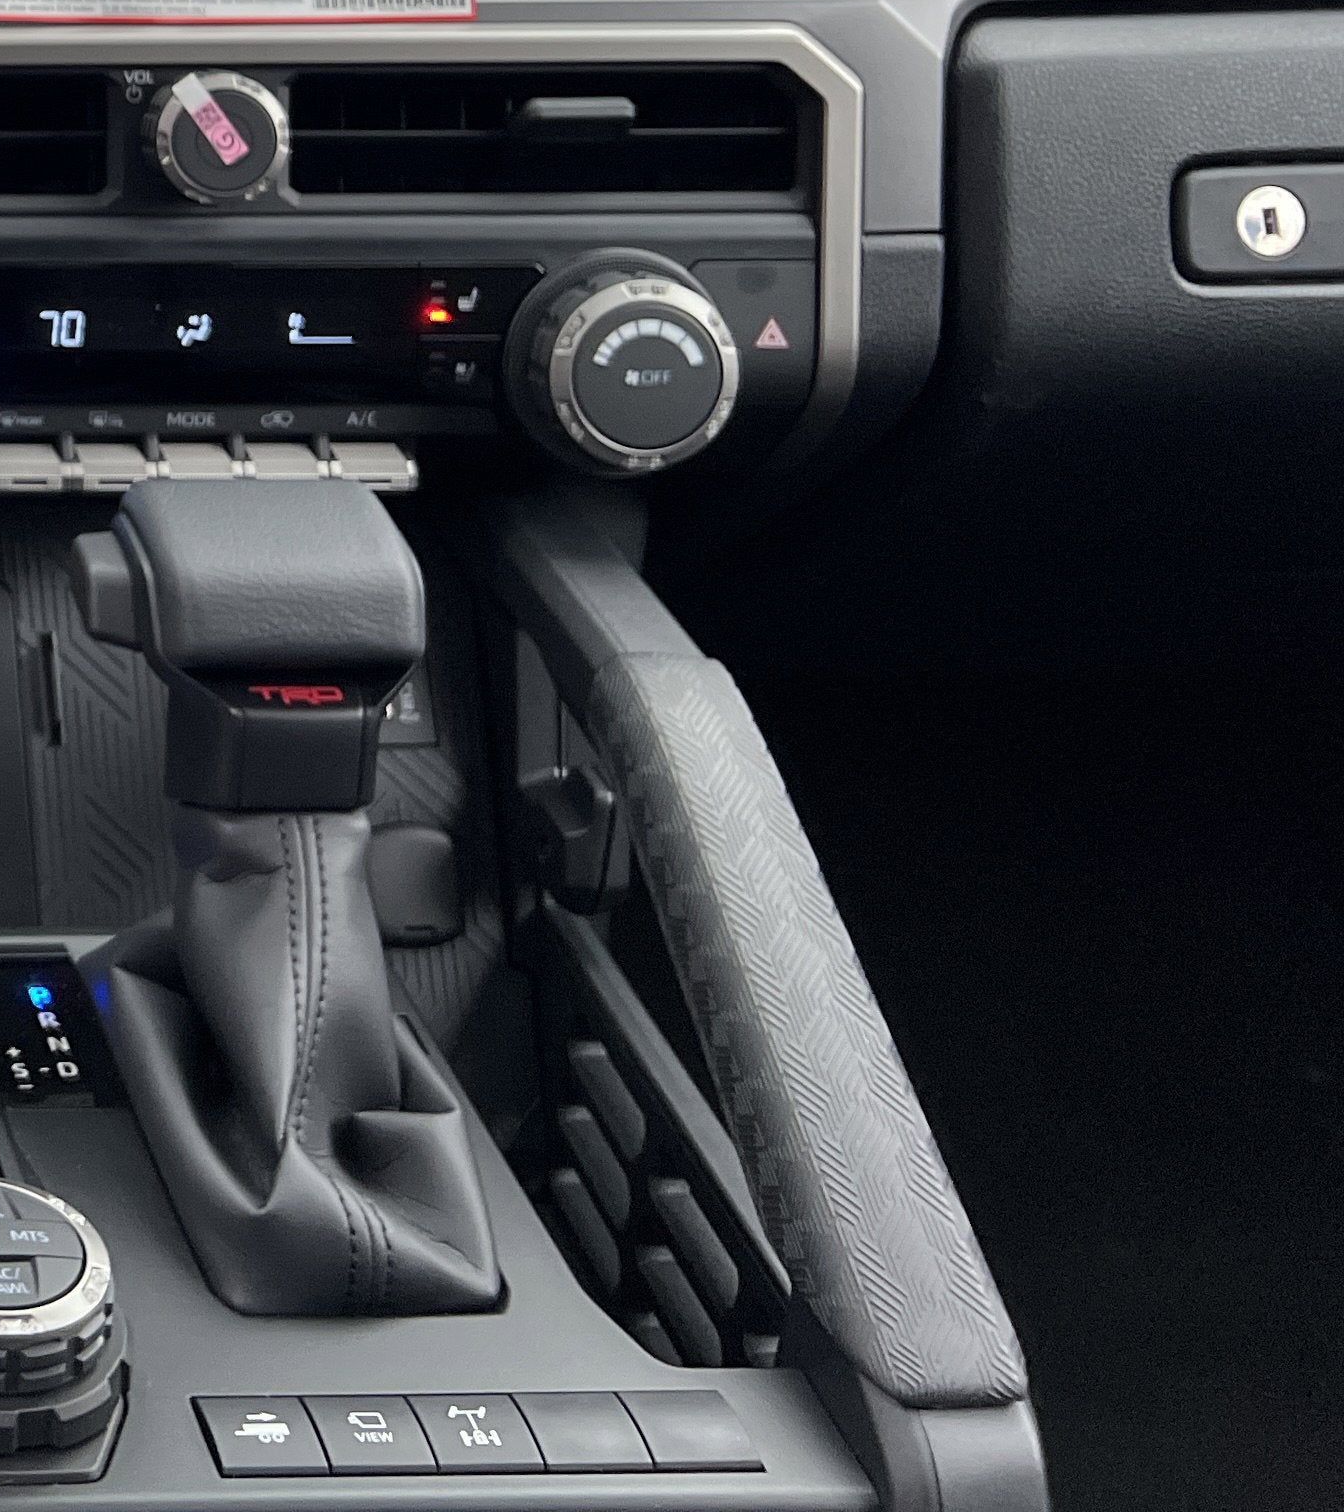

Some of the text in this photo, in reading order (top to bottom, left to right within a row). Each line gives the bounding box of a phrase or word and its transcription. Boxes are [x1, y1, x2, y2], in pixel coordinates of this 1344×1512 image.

[123, 70, 154, 85] VOL
[40, 310, 86, 347] 70
[640, 369, 672, 385] OFF
[166, 411, 216, 429] MODE
[248, 685, 345, 705] TRD
[28, 986, 53, 1009] P
[38, 1011, 62, 1030] R
[47, 1036, 71, 1053] N
[12, 1061, 80, 1079] S D
[10, 1230, 50, 1243] MTS
[353, 1430, 394, 1444] VIEW
